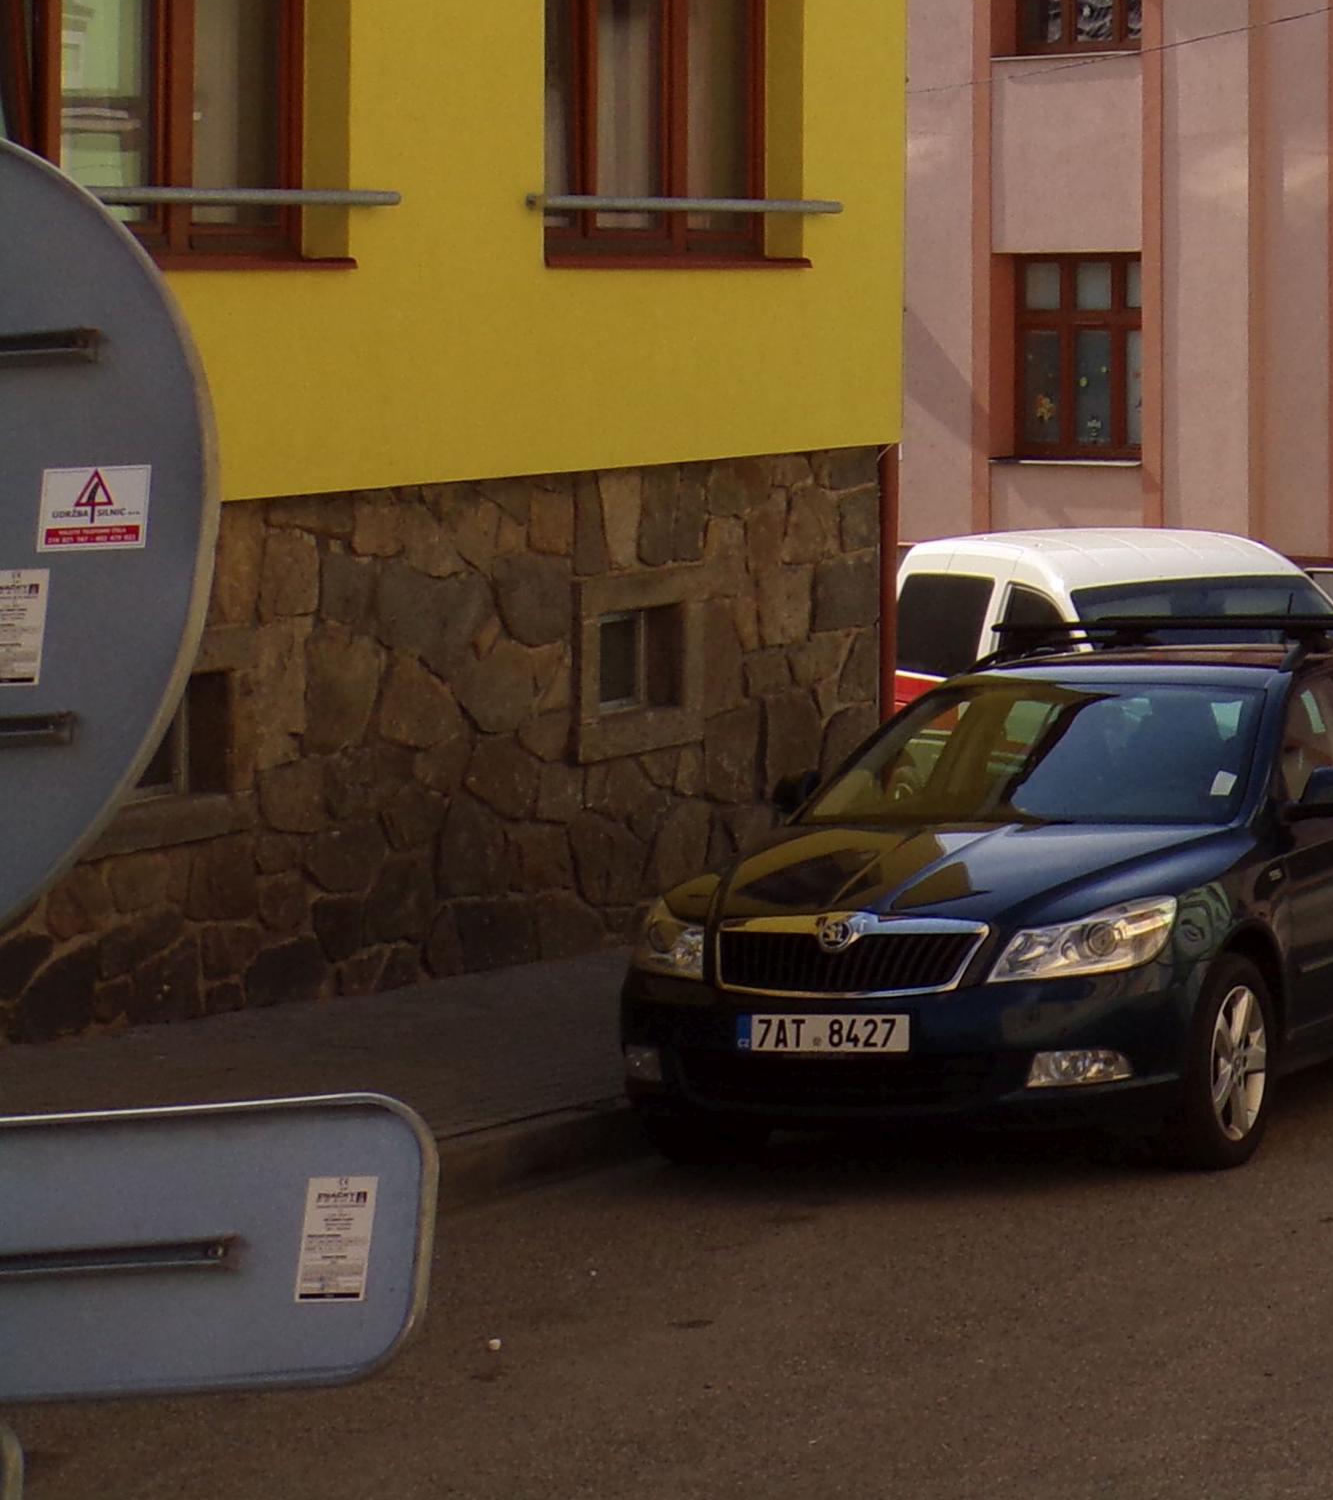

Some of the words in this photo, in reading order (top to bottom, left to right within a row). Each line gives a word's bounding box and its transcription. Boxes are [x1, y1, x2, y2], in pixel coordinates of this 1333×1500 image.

[97, 508, 126, 517] SILNIC
[737, 1038, 750, 1048] CZ
[757, 1018, 806, 1048] 7AT
[828, 1018, 897, 1048] 8427
